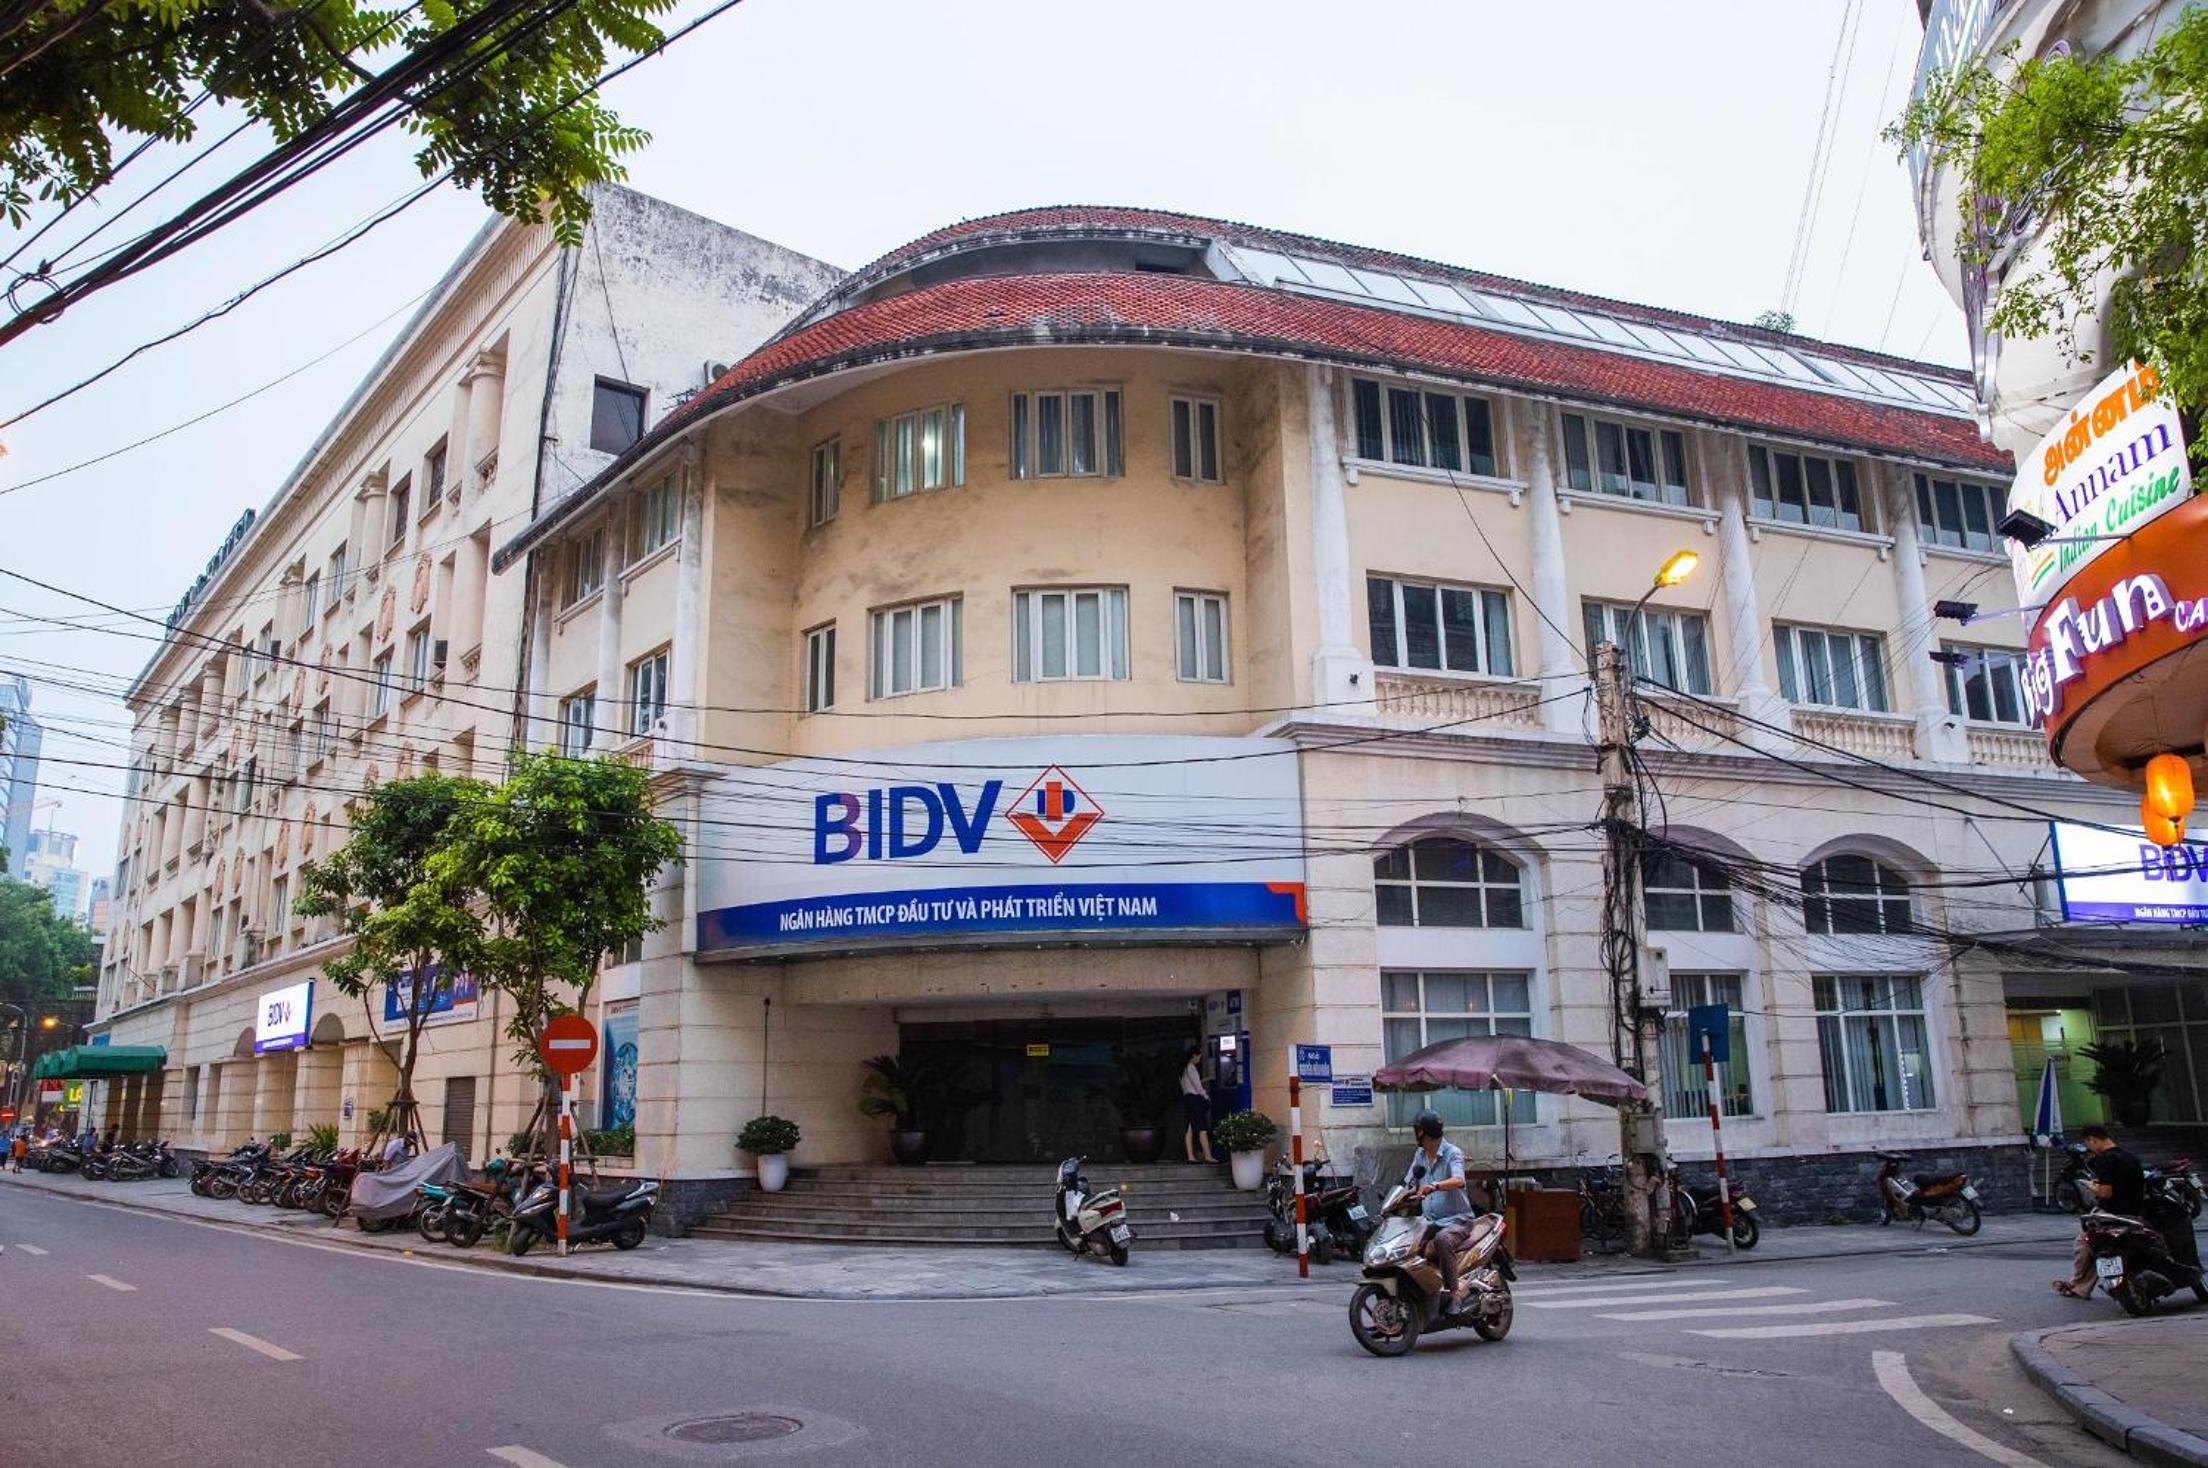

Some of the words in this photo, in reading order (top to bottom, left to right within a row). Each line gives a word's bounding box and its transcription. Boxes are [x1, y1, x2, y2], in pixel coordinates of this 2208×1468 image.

[2055, 423, 2174, 523] Annam
[2060, 520, 2098, 573] Indian
[2105, 466, 2181, 532] Cuisine
[2044, 574, 2172, 683] Fun
[814, 780, 1003, 864] BIDV
[2139, 844, 2208, 883] BIDV
[779, 908, 813, 931] NGÂN
[816, 905, 853, 929] HÀNG
[855, 905, 895, 925] TMCP
[898, 898, 928, 922] ĐẦU
[931, 899, 954, 921] TƯ
[956, 896, 977, 919] VÀ
[981, 895, 1023, 919] PHÁT
[1026, 891, 1075, 917] TRIỂN
[1078, 893, 1115, 922] VIỆT
[1118, 896, 1158, 916] NAM
